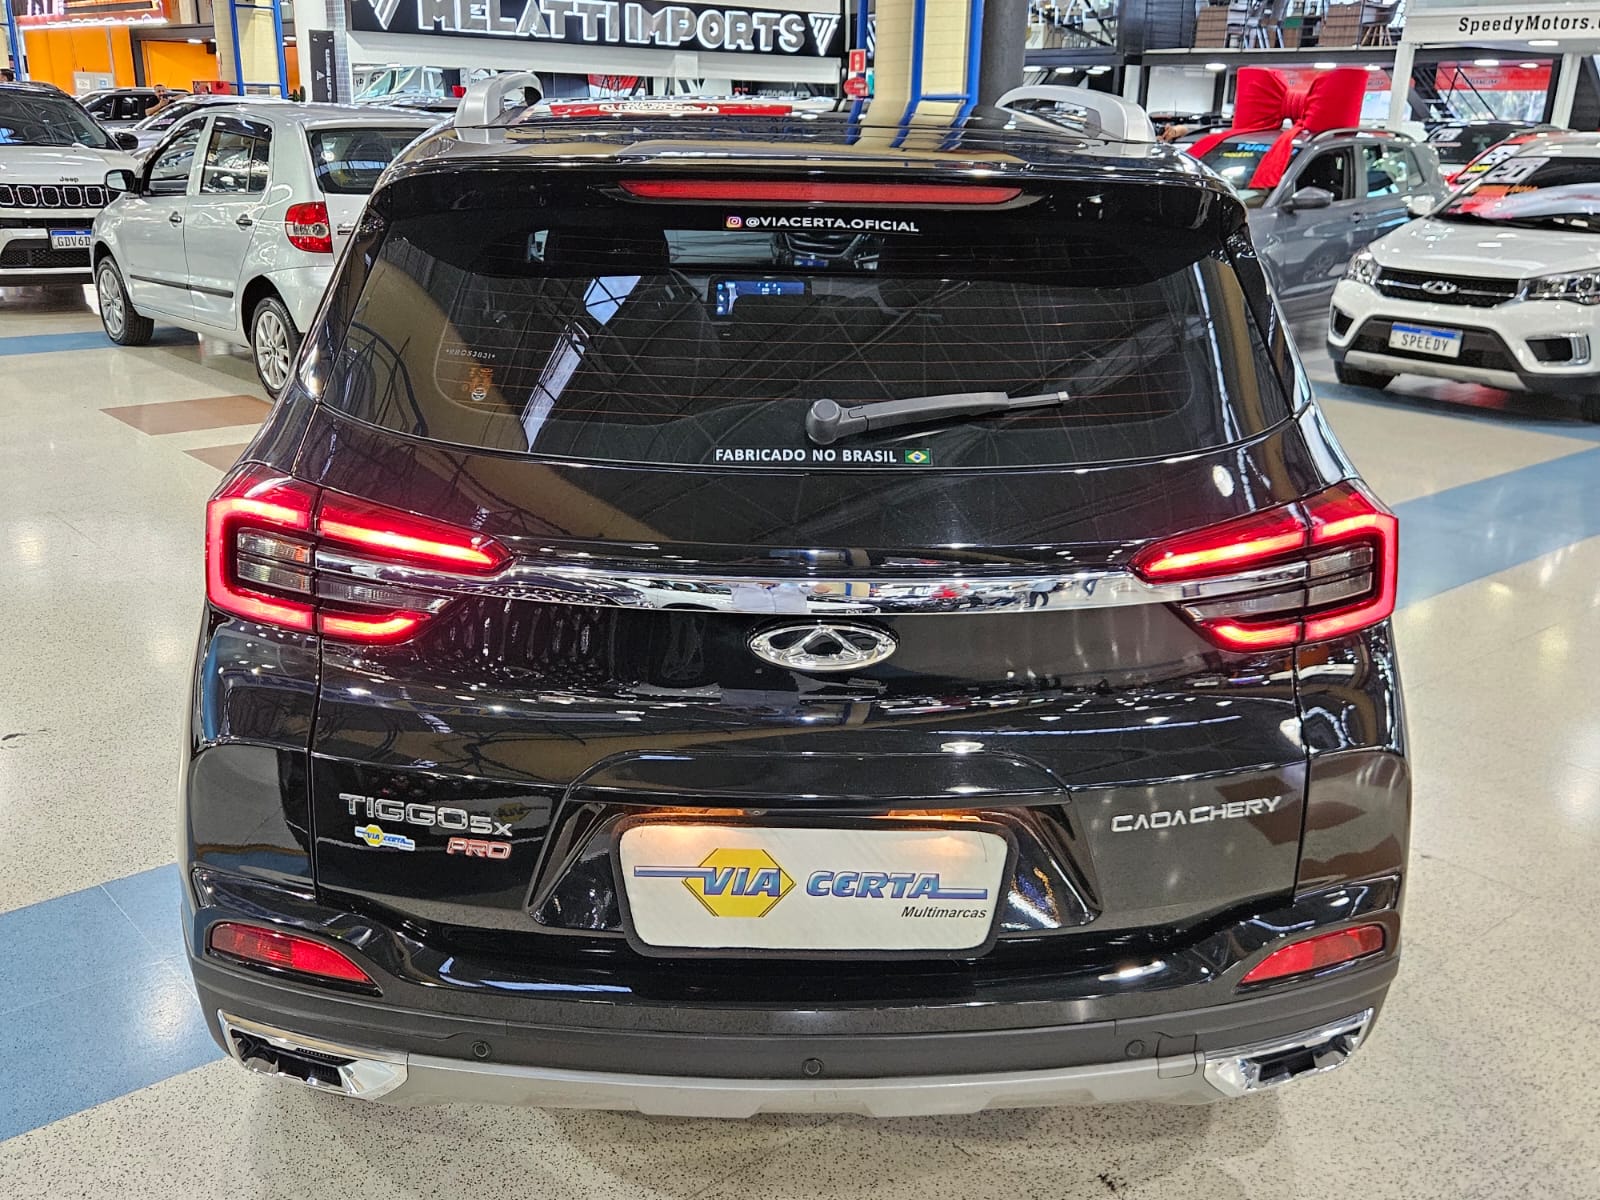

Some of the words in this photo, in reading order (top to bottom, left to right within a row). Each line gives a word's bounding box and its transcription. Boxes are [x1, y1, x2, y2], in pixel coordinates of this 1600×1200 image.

[417, 0, 620, 42] MELATTI
[624, 4, 806, 53] IMPORTS
[745, 216, 920, 232] @VIACERTA.OFICIAL
[1400, 333, 1449, 352] SPEEDY
[715, 448, 806, 462] FABRICADO
[812, 448, 836, 462] NO
[842, 449, 897, 463] BRASIL
[1188, 796, 1282, 823] CHERY
[367, 832, 380, 841] VIA
[446, 837, 512, 860] PRO
[704, 866, 780, 897] VIA
[806, 870, 939, 898] CERTA
[901, 906, 986, 919] Multimarcas
